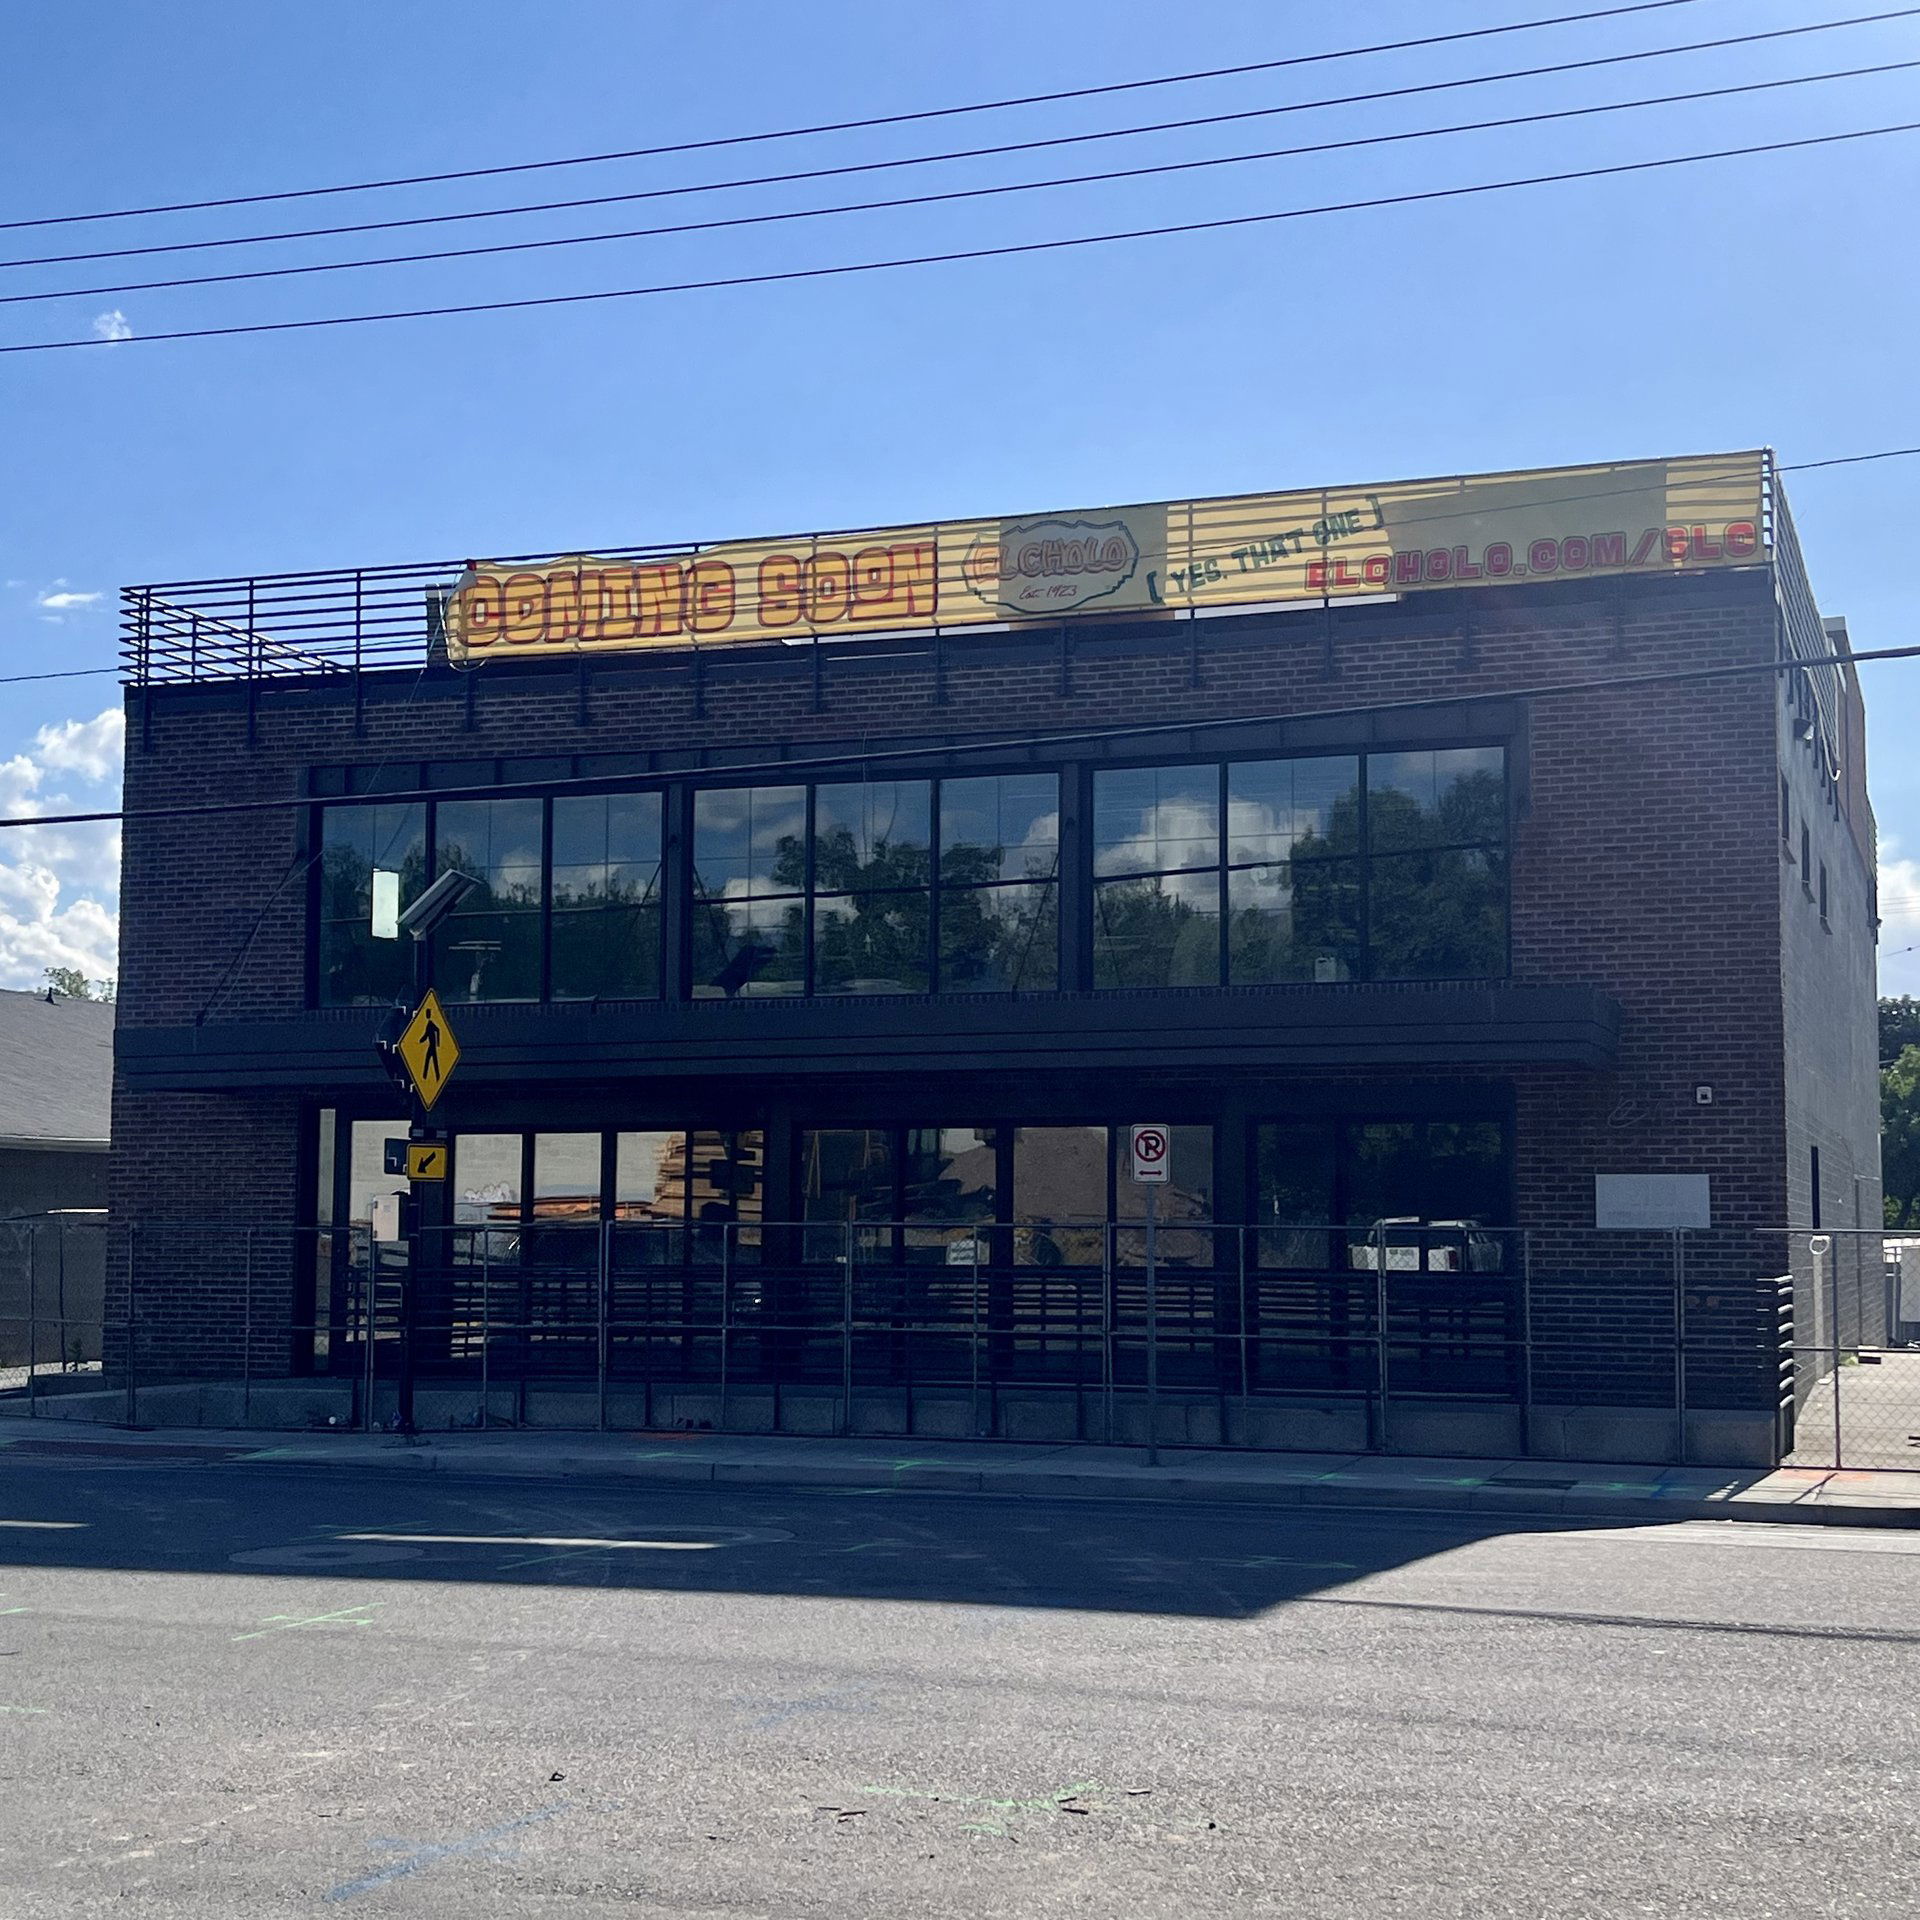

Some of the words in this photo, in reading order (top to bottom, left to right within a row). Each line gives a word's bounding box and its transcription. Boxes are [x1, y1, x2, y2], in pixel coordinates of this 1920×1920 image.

[974, 545, 1018, 583] EL
[1018, 536, 1127, 577] CHOLO
[1231, 528, 1304, 573] THAT
[457, 561, 735, 647] COMING
[758, 541, 939, 627] SOON
